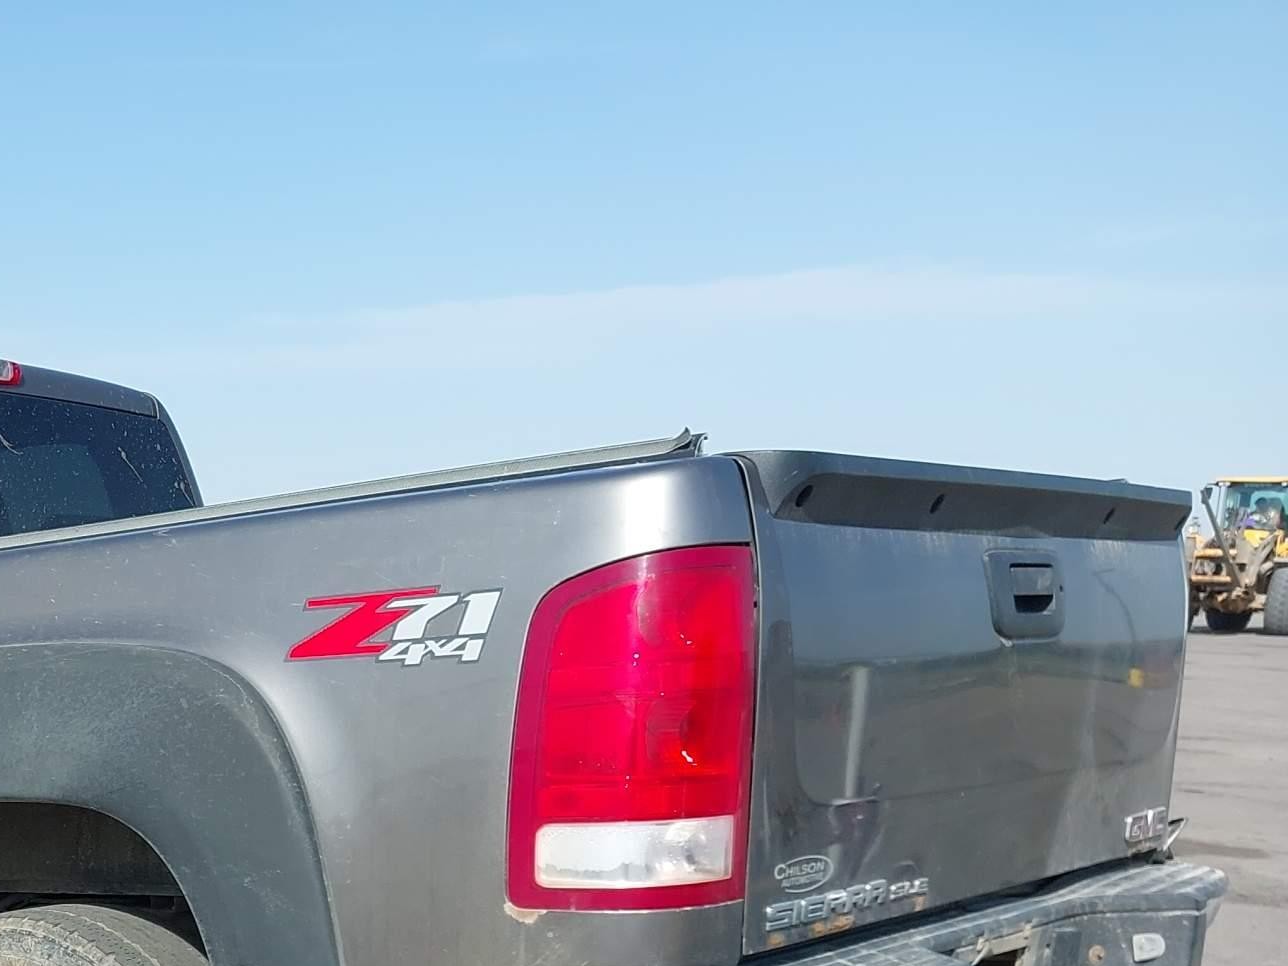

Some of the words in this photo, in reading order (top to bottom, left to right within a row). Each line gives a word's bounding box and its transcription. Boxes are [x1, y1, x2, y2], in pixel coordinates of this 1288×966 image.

[285, 584, 503, 662] Z71
[774, 859, 826, 880] CHILSON
[765, 878, 888, 931] SIERRA
[889, 877, 929, 901] SLE
